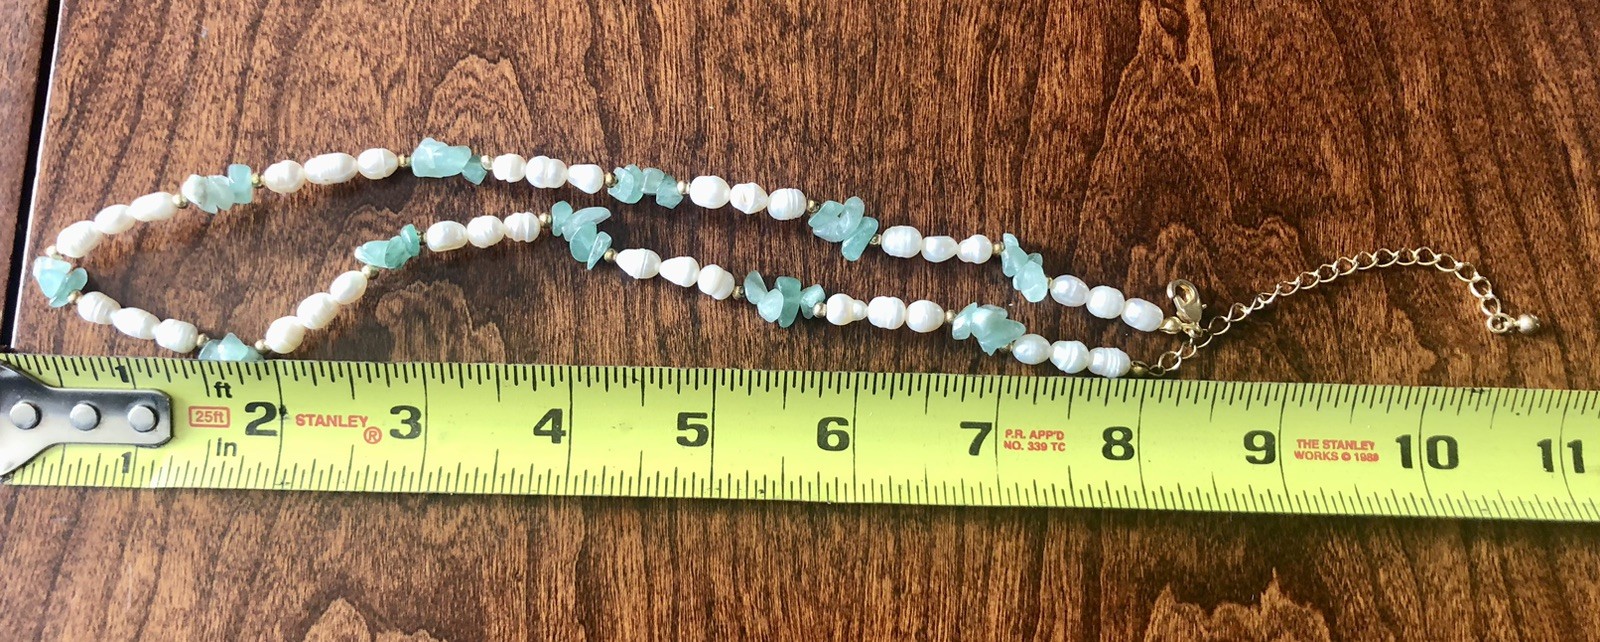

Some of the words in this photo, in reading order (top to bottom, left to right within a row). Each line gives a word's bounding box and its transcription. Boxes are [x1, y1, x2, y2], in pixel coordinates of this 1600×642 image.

[115, 365, 129, 383] 1
[214, 381, 232, 398] ft
[195, 410, 225, 423] 25ft
[244, 401, 278, 437] 2
[295, 413, 368, 428] STANLEY
[389, 405, 422, 439] 3
[533, 408, 567, 444] 4
[676, 412, 709, 447] 5
[216, 437, 237, 457] in
[816, 416, 850, 451] 6
[960, 421, 992, 456] 7
[1003, 440, 1024, 451] NO.
[1027, 441, 1048, 451] 339
[1050, 442, 1066, 452] TC
[1005, 429, 1026, 439] P.R.
[1029, 430, 1065, 440] APP'D
[1102, 426, 1135, 461] 8
[1243, 430, 1276, 465] 9
[1296, 439, 1319, 449] THE
[1322, 439, 1375, 450] STANLEY
[121, 451, 131, 473] 1
[1294, 450, 1338, 461] WORKS
[1395, 434, 1459, 470] 10
[1537, 438, 1585, 473] 11
